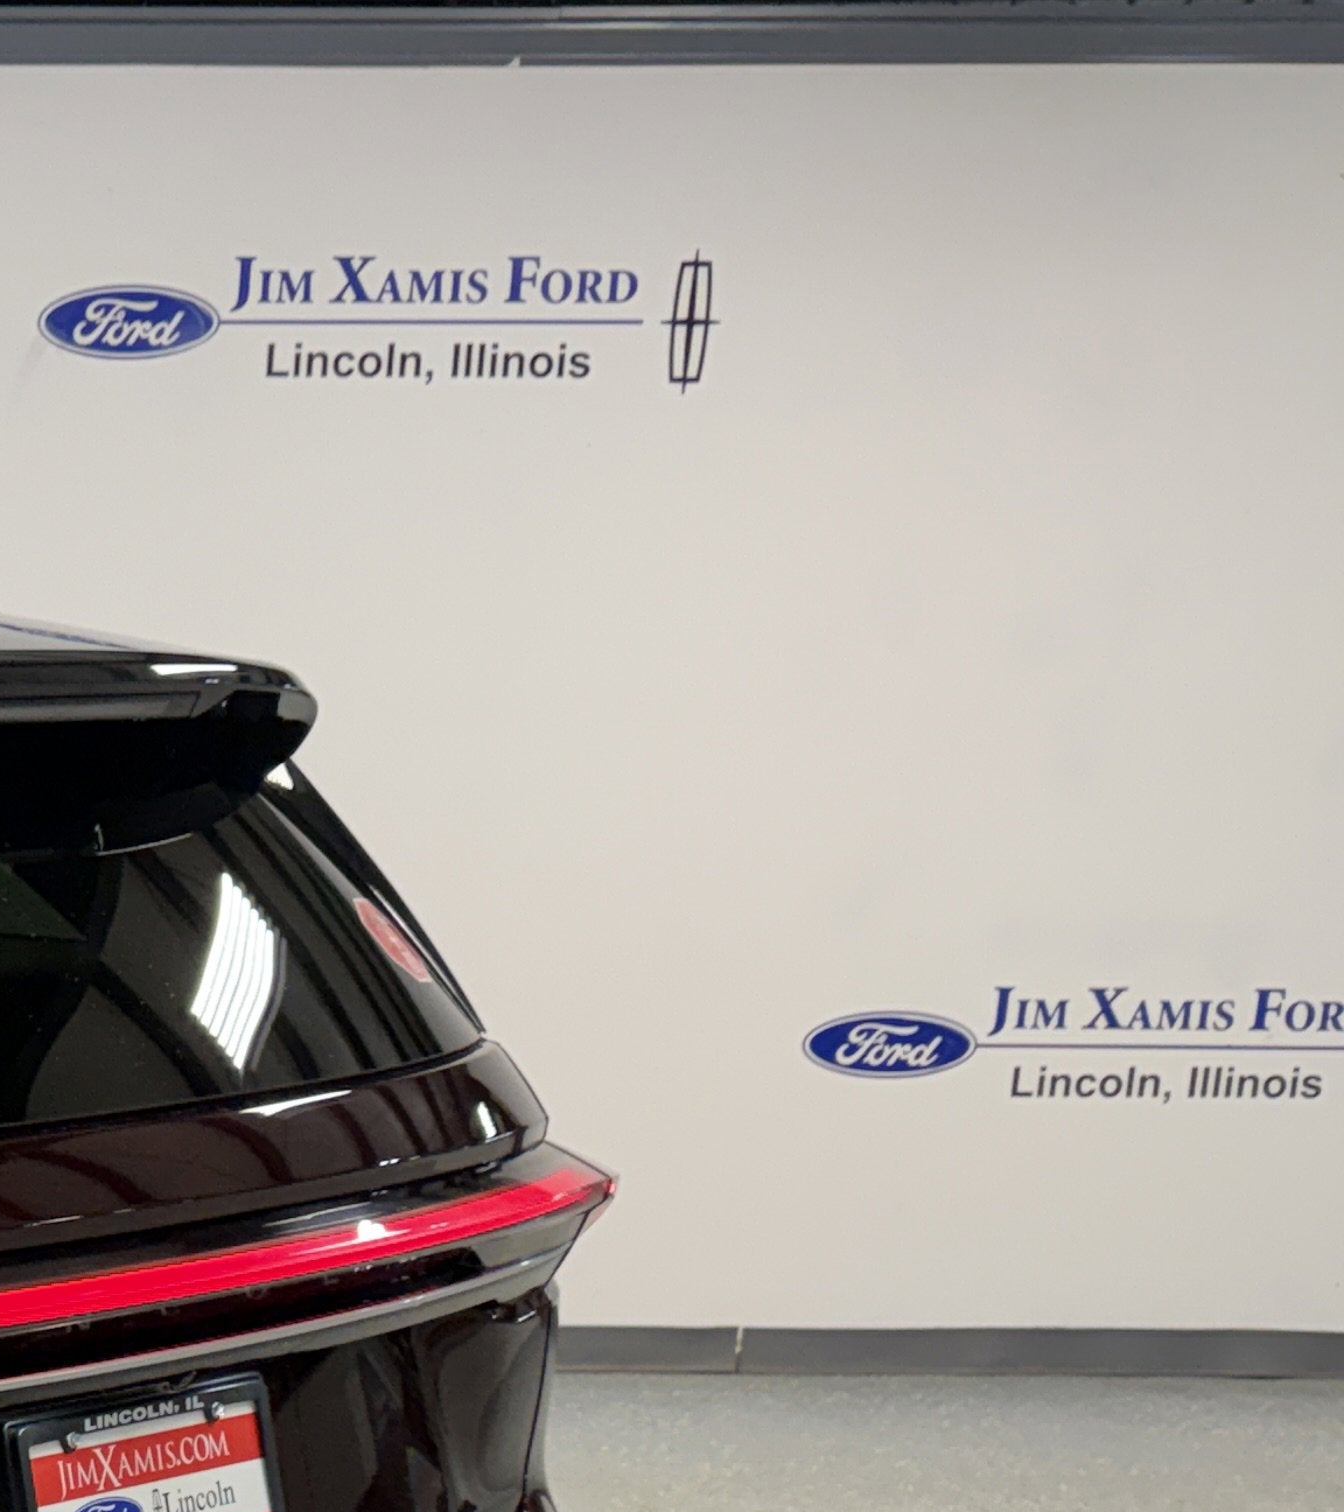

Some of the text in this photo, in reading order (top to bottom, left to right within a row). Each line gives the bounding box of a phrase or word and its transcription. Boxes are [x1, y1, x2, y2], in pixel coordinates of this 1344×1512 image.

[229, 255, 640, 314] JIM XAMIS FORD
[265, 342, 593, 387] Lincoln, Illinois
[986, 986, 1344, 1038] JIM XAMIS FOR
[1010, 1065, 1324, 1105] Lincoln, Illinois
[84, 1394, 205, 1433] LINCOLN, IL
